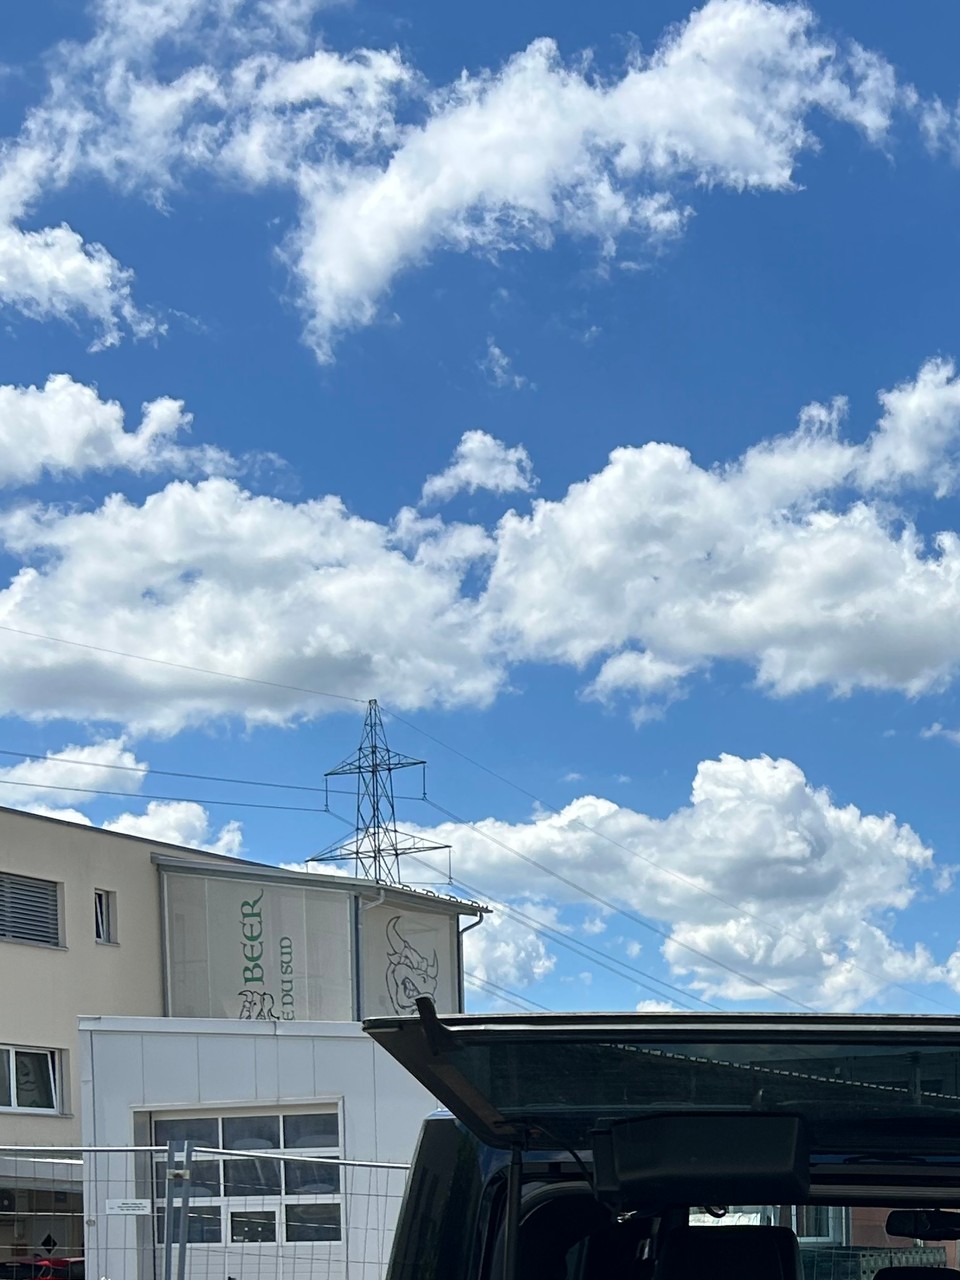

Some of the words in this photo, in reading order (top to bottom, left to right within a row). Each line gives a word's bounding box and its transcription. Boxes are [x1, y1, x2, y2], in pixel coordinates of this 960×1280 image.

[240, 888, 264, 986] BEER
[279, 936, 294, 976] SUD
[280, 979, 295, 1007] DU
